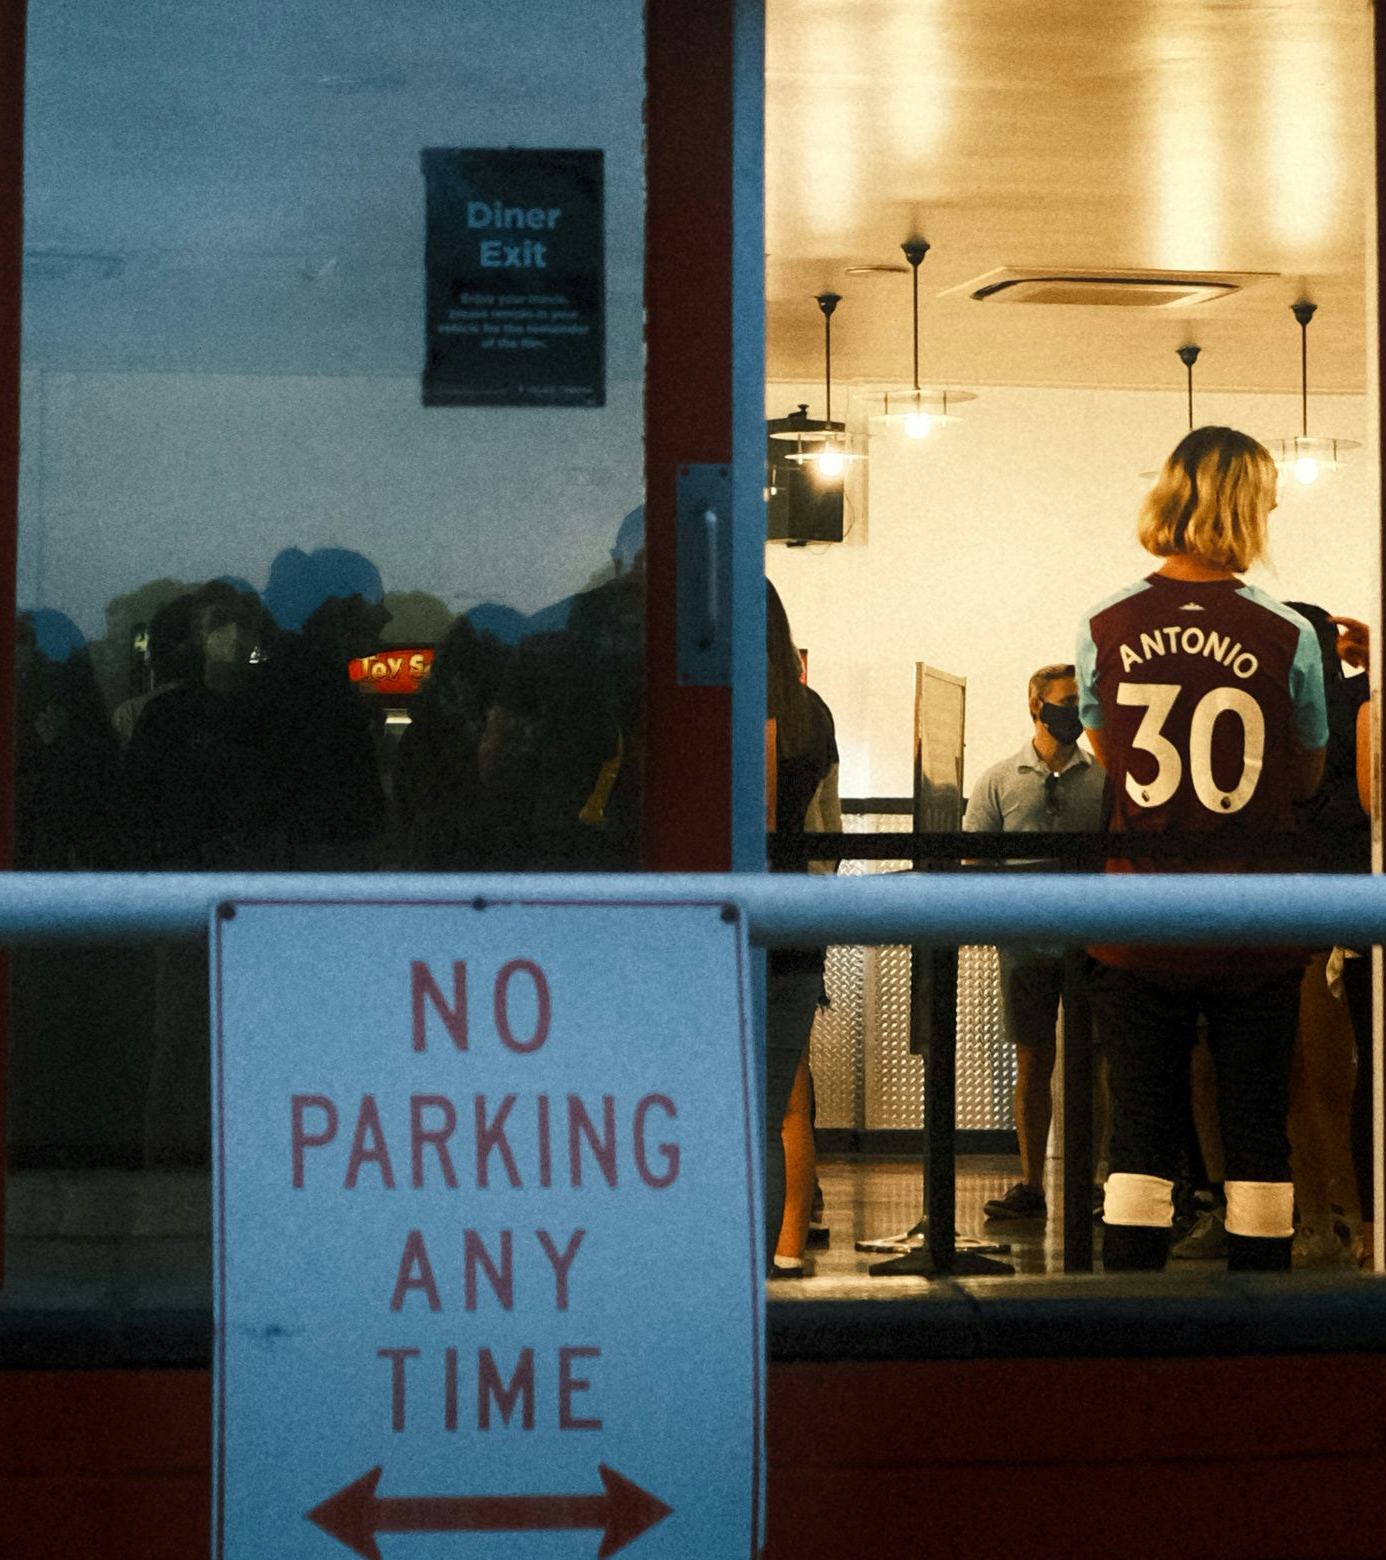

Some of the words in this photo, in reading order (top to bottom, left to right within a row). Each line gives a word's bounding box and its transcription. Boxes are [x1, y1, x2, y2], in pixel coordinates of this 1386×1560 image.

[466, 200, 562, 230] Diner
[479, 239, 548, 268] Exit
[1118, 626, 1260, 680] ANTONIO
[1115, 681, 1267, 815] 30
[410, 958, 553, 1055] NO
[290, 1092, 682, 1190] PARKING
[389, 1228, 587, 1312] ANY
[377, 1347, 604, 1432] TIME
